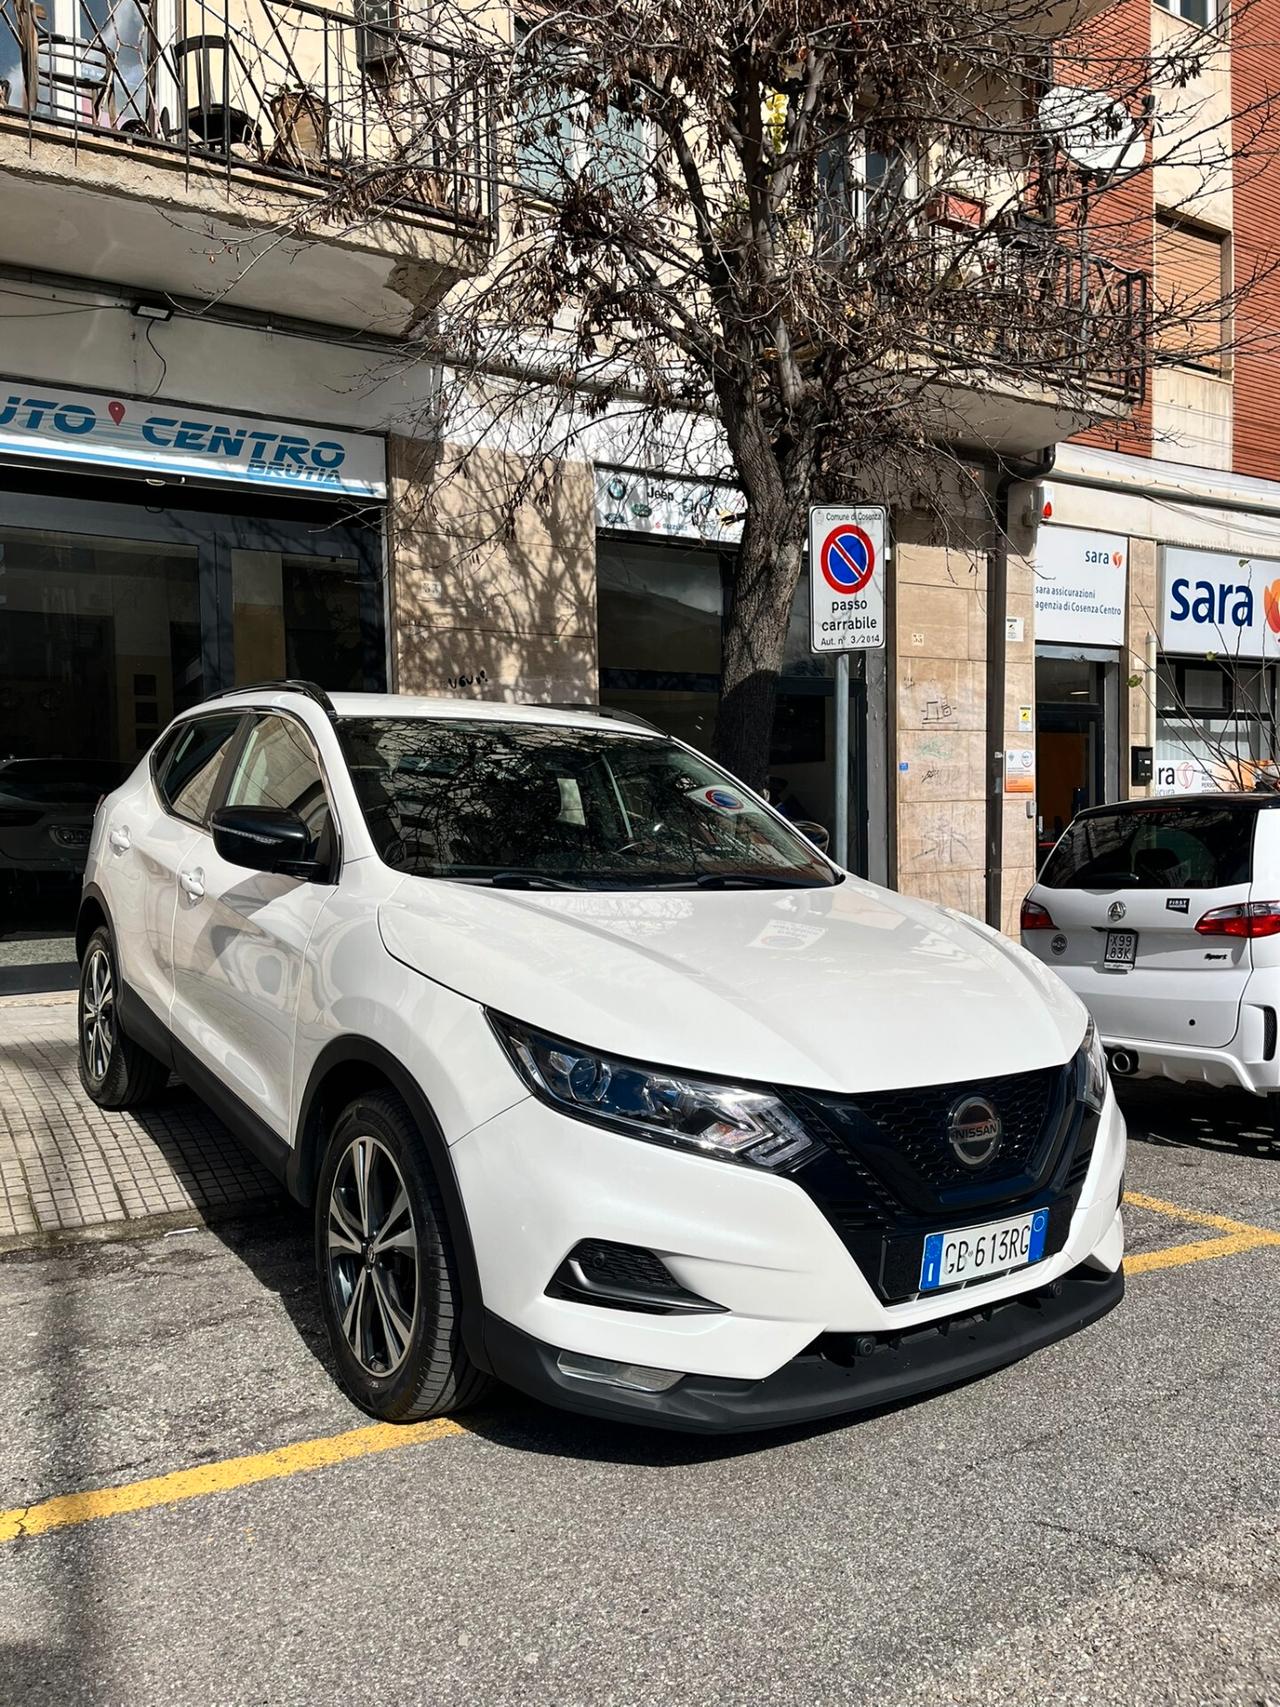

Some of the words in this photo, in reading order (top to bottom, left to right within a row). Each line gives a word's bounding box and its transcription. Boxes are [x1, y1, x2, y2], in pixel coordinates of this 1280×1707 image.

[142, 416, 346, 468] CENTRO
[247, 460, 341, 484] BRUTIA
[647, 487, 674, 503] Jeep
[825, 512, 850, 521] Comune
[1084, 549, 1110, 565] sara
[1035, 585, 1050, 595] sara
[1051, 586, 1096, 599] assicurazioni
[831, 599, 868, 613] passo
[1035, 600, 1062, 612] agenzia
[1063, 601, 1071, 611] di
[1071, 602, 1099, 614] Cosenza
[1099, 604, 1122, 615] Centro
[1170, 578, 1254, 627] sara
[821, 616, 877, 632] carrabile
[850, 634, 880, 644] 3/2014
[1111, 935, 1132, 947] X99
[1110, 947, 1131, 960] 83K
[1204, 953, 1228, 961] Sport
[954, 1122, 997, 1139] NISSAN
